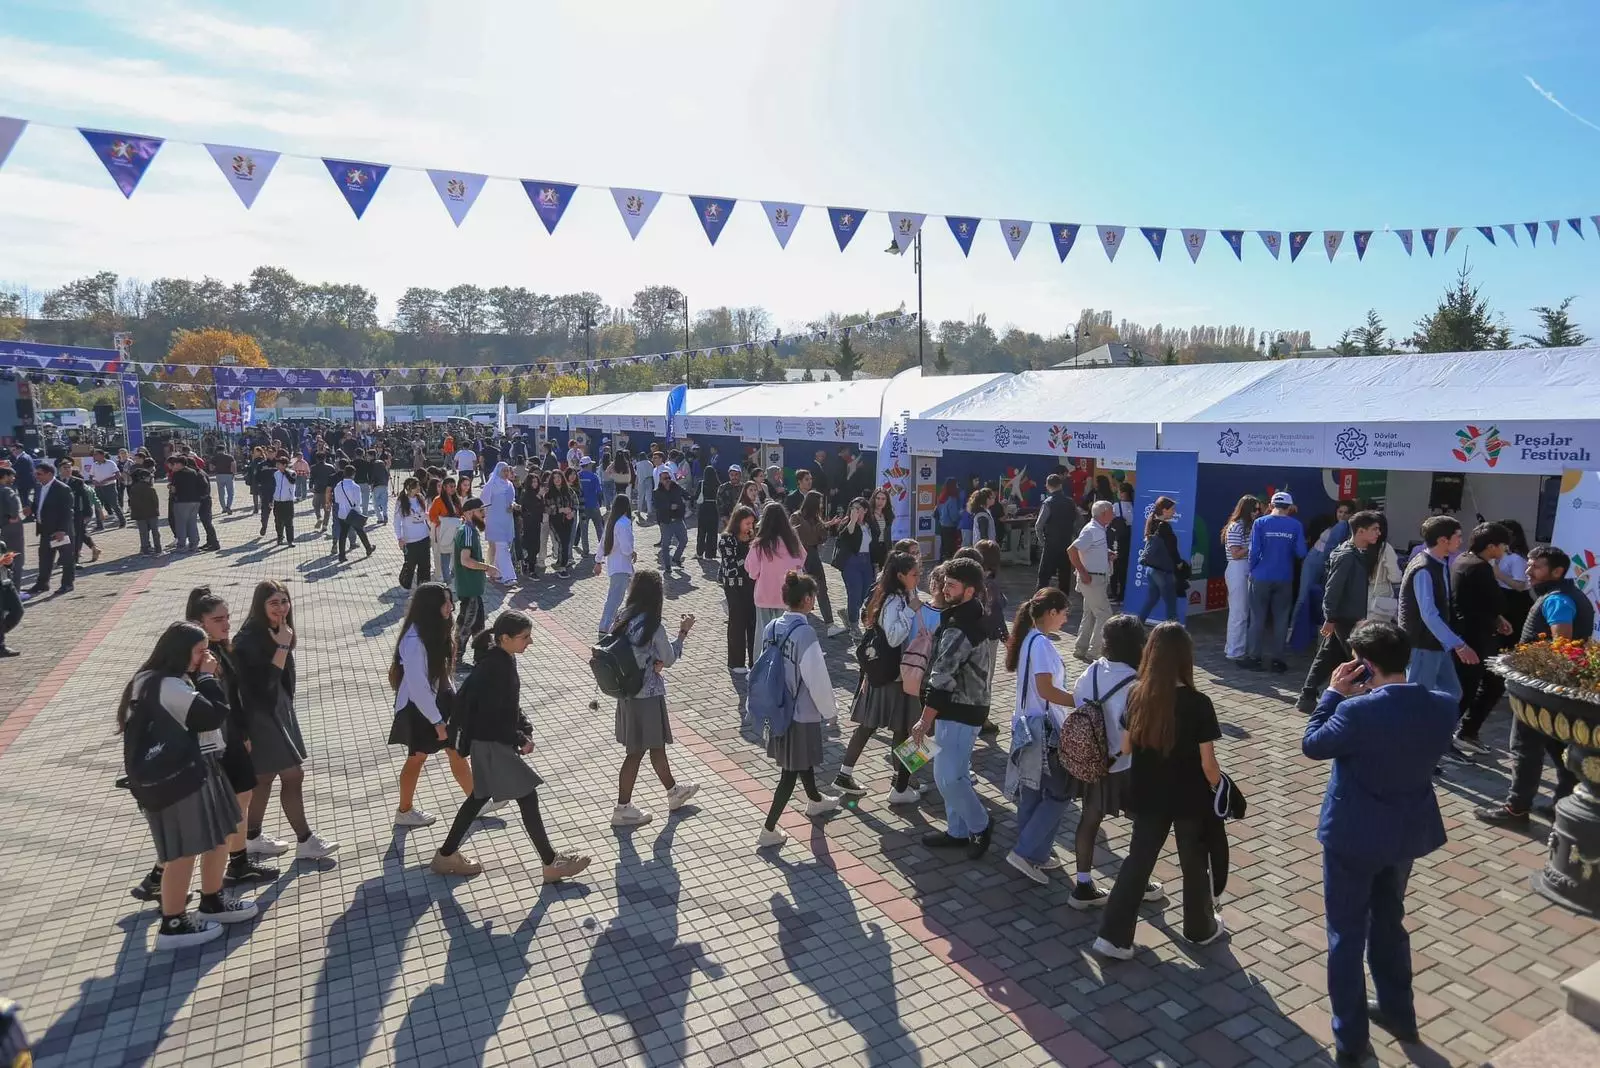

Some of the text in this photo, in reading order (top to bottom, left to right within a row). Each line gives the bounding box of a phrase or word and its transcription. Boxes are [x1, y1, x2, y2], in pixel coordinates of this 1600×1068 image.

[1073, 430, 1098, 441] Peşələr
[1513, 432, 1573, 448] Peşələr
[1077, 440, 1106, 450] Festivalı
[1521, 448, 1591, 462] Festivalı
